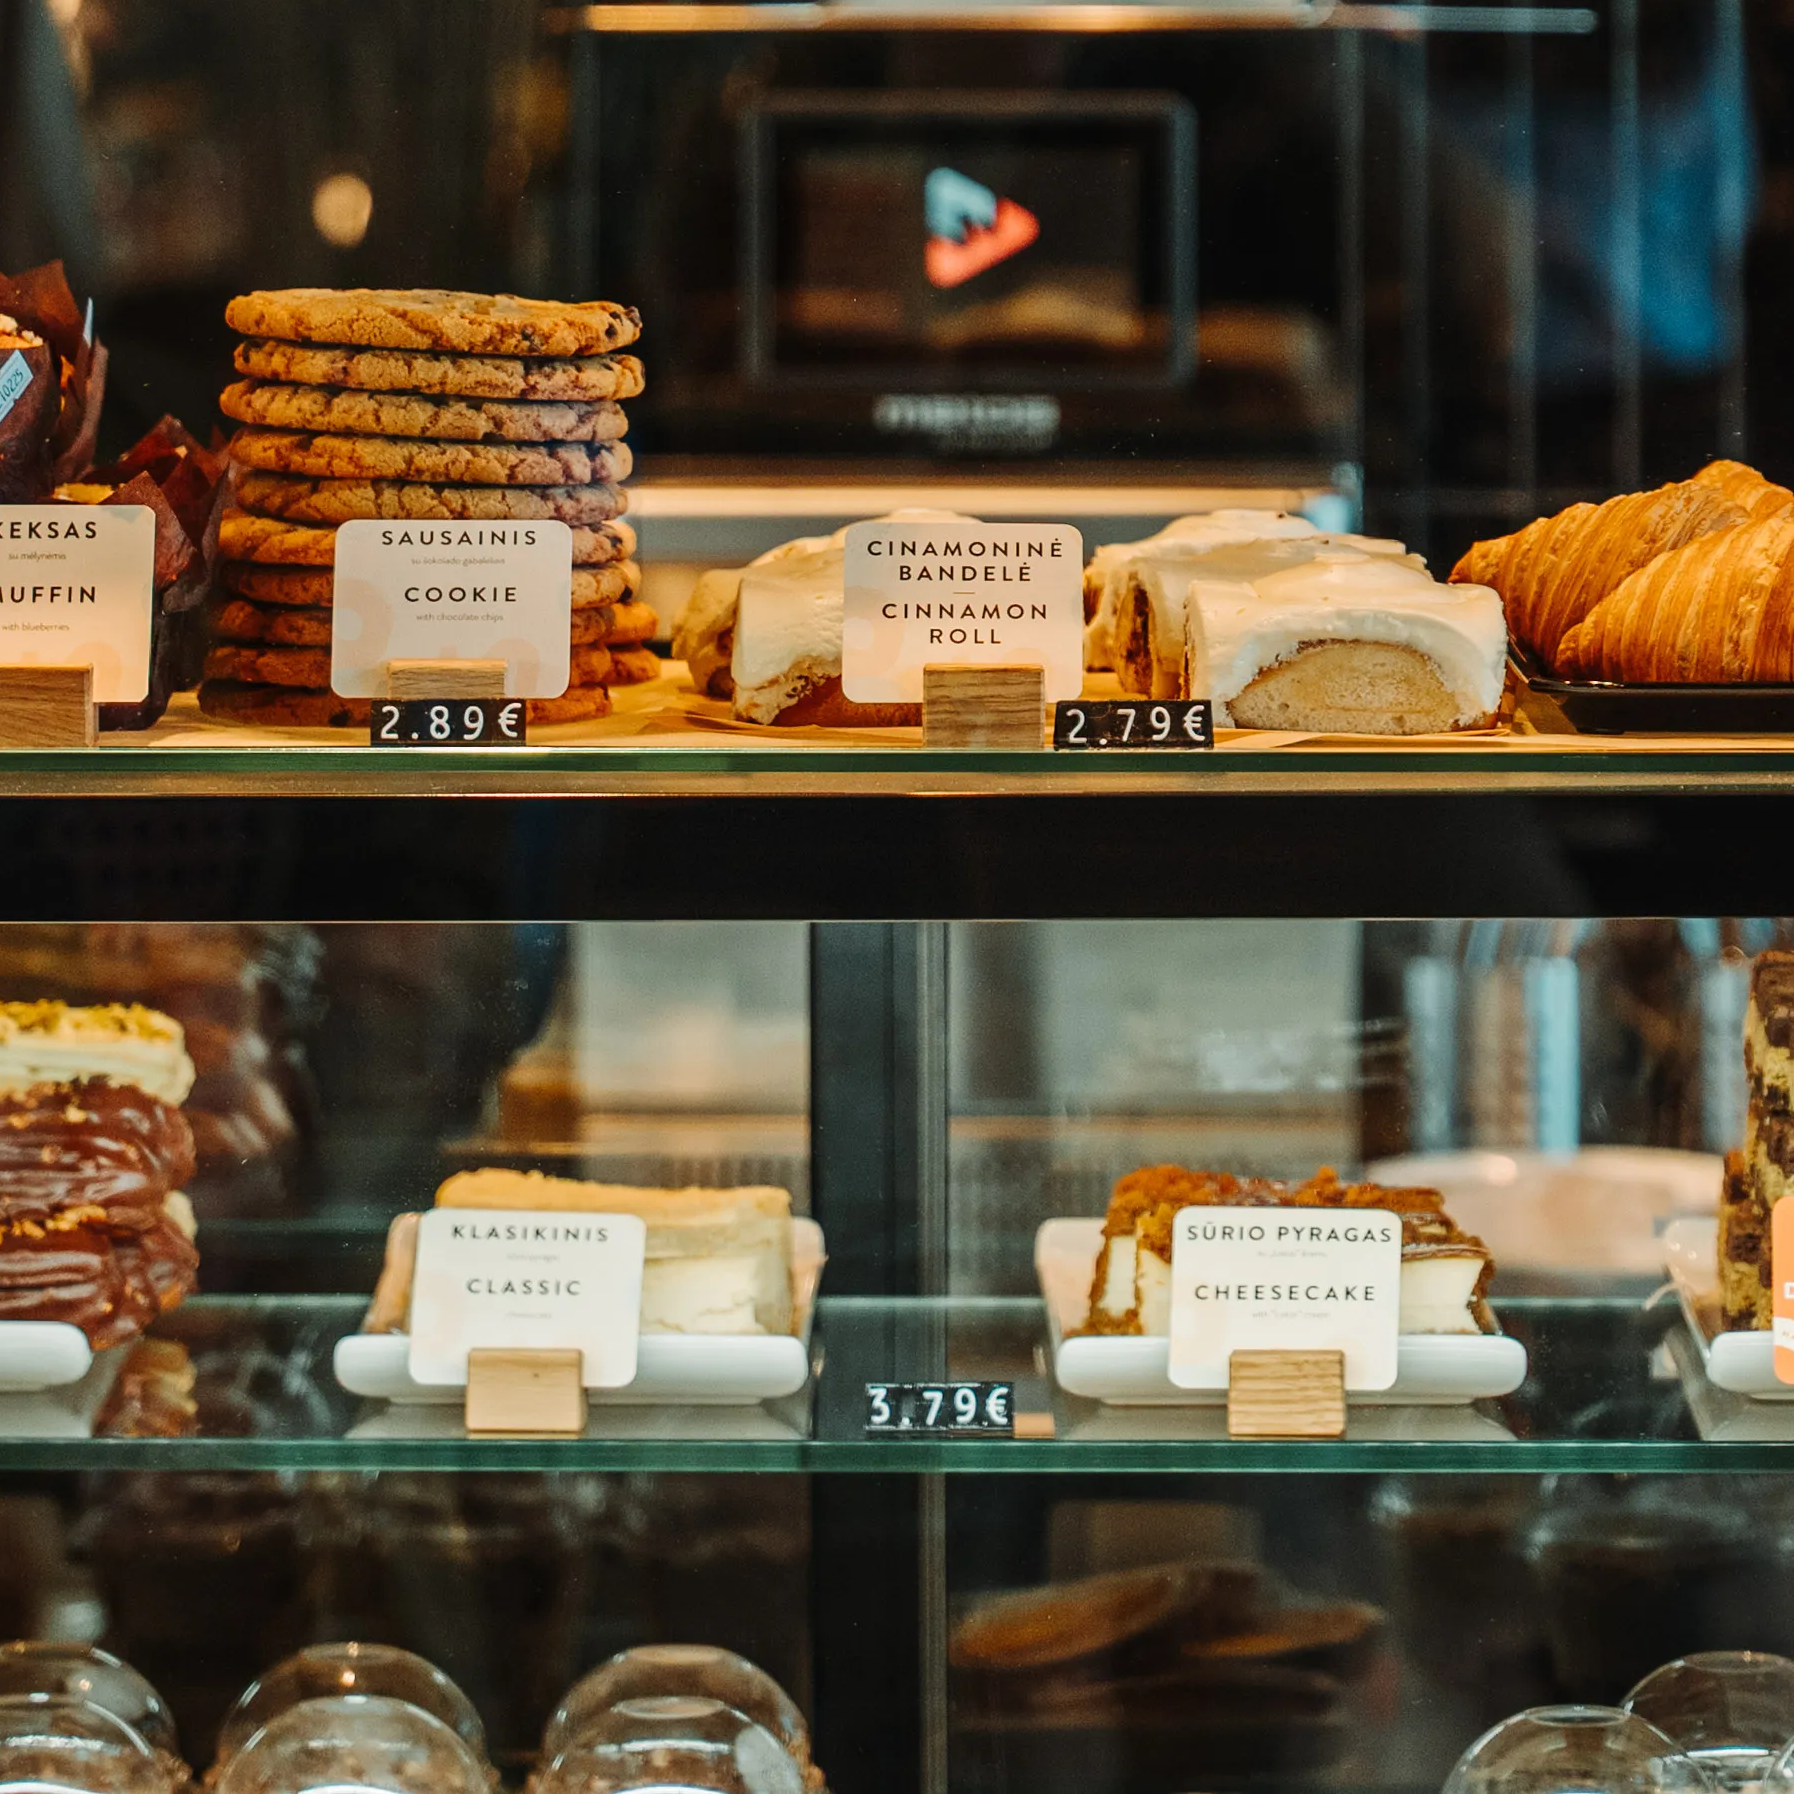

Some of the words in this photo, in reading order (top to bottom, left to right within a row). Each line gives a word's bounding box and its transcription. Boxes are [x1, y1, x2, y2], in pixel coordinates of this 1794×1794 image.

[381, 530, 537, 546] SAUSAINIS
[867, 537, 1064, 558] CINAMONINĖ
[899, 562, 1032, 582] BANDELĖ
[404, 586, 517, 602] COOKIE
[882, 603, 1048, 620] CINNAMON
[929, 628, 1002, 645] ROLL
[380, 702, 522, 741] 2.89€
[1065, 705, 1206, 746] 2.79€
[452, 1225, 610, 1243] KLASIKINIS
[1187, 1220, 1266, 1243] SŪRIO
[1277, 1223, 1393, 1243] PYRAGAS
[467, 1279, 582, 1296] CLASSIC
[1195, 1284, 1377, 1302] CHEESECAKE
[869, 1386, 1010, 1426] 3.79€
